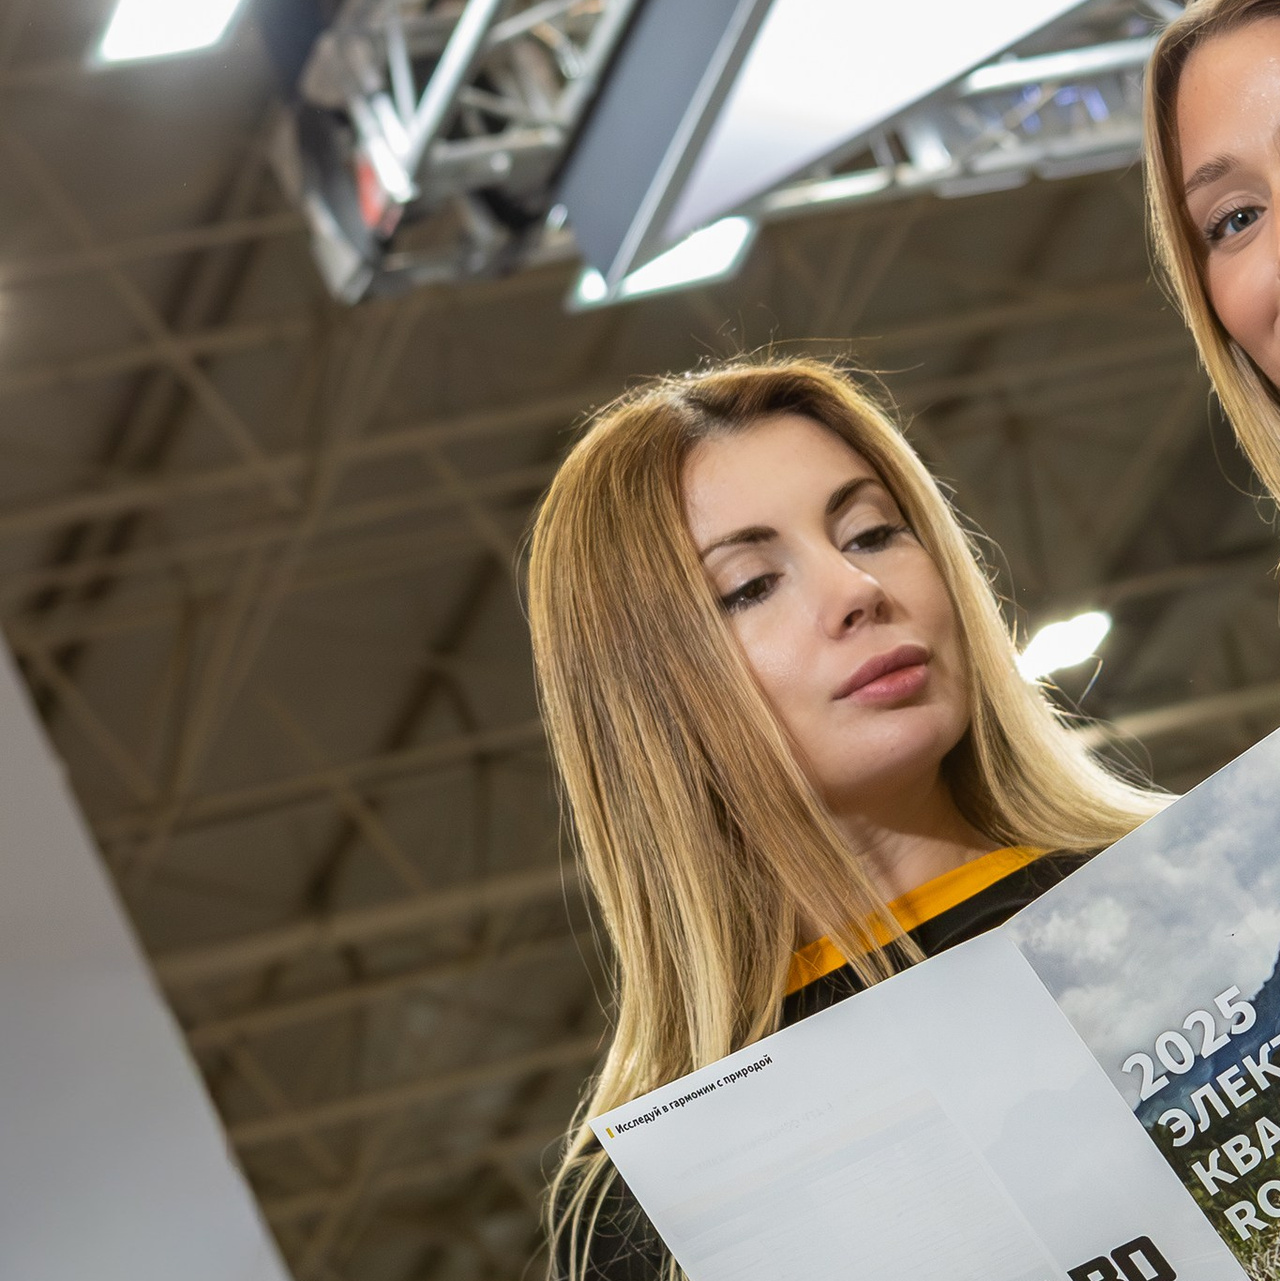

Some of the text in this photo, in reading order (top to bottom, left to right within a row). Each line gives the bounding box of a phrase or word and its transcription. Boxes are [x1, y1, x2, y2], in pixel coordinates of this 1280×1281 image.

[1122, 985, 1257, 1101] 2025
[614, 1054, 773, 1134] Исследуй в гармонии с природой
